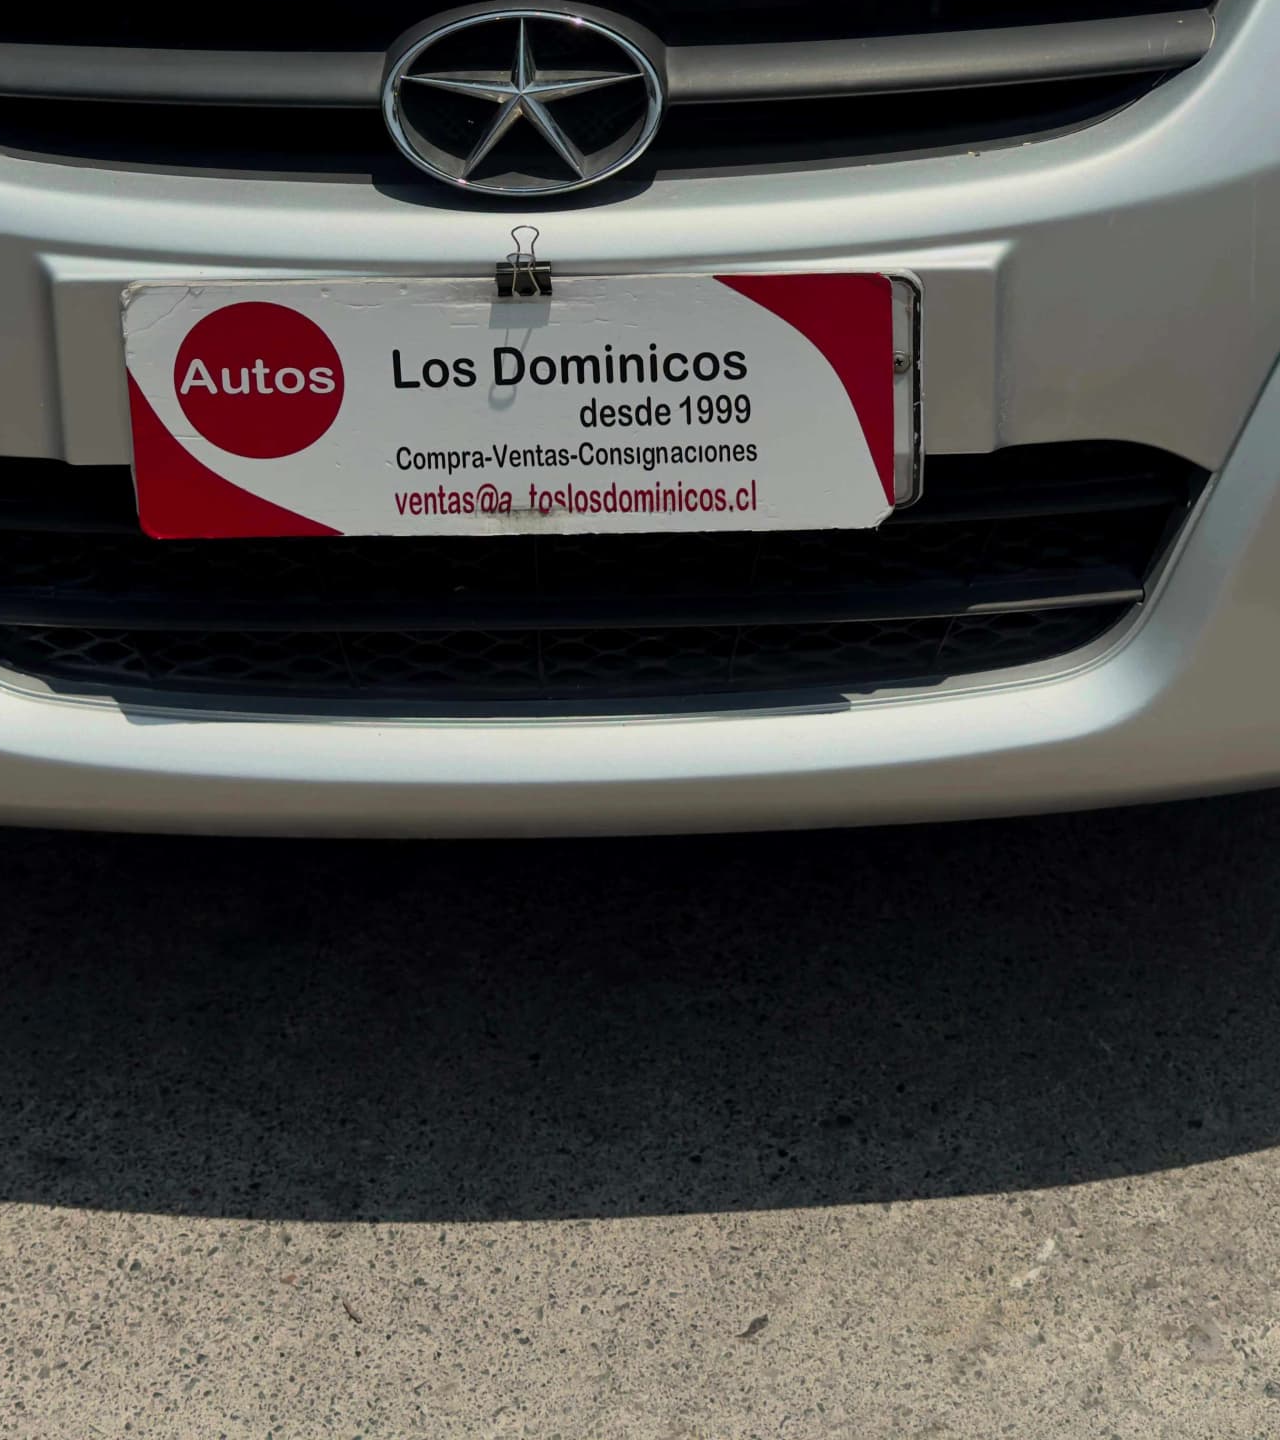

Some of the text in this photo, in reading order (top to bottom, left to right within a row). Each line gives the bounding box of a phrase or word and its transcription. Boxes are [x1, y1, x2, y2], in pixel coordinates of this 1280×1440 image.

[180, 343, 748, 395] Autos Los Dominicos
[579, 394, 751, 428] desde 1999
[396, 441, 758, 475] Compra-Ventas-Consignaciones
[395, 480, 757, 515] ventas@atoslosdominicos.cl
